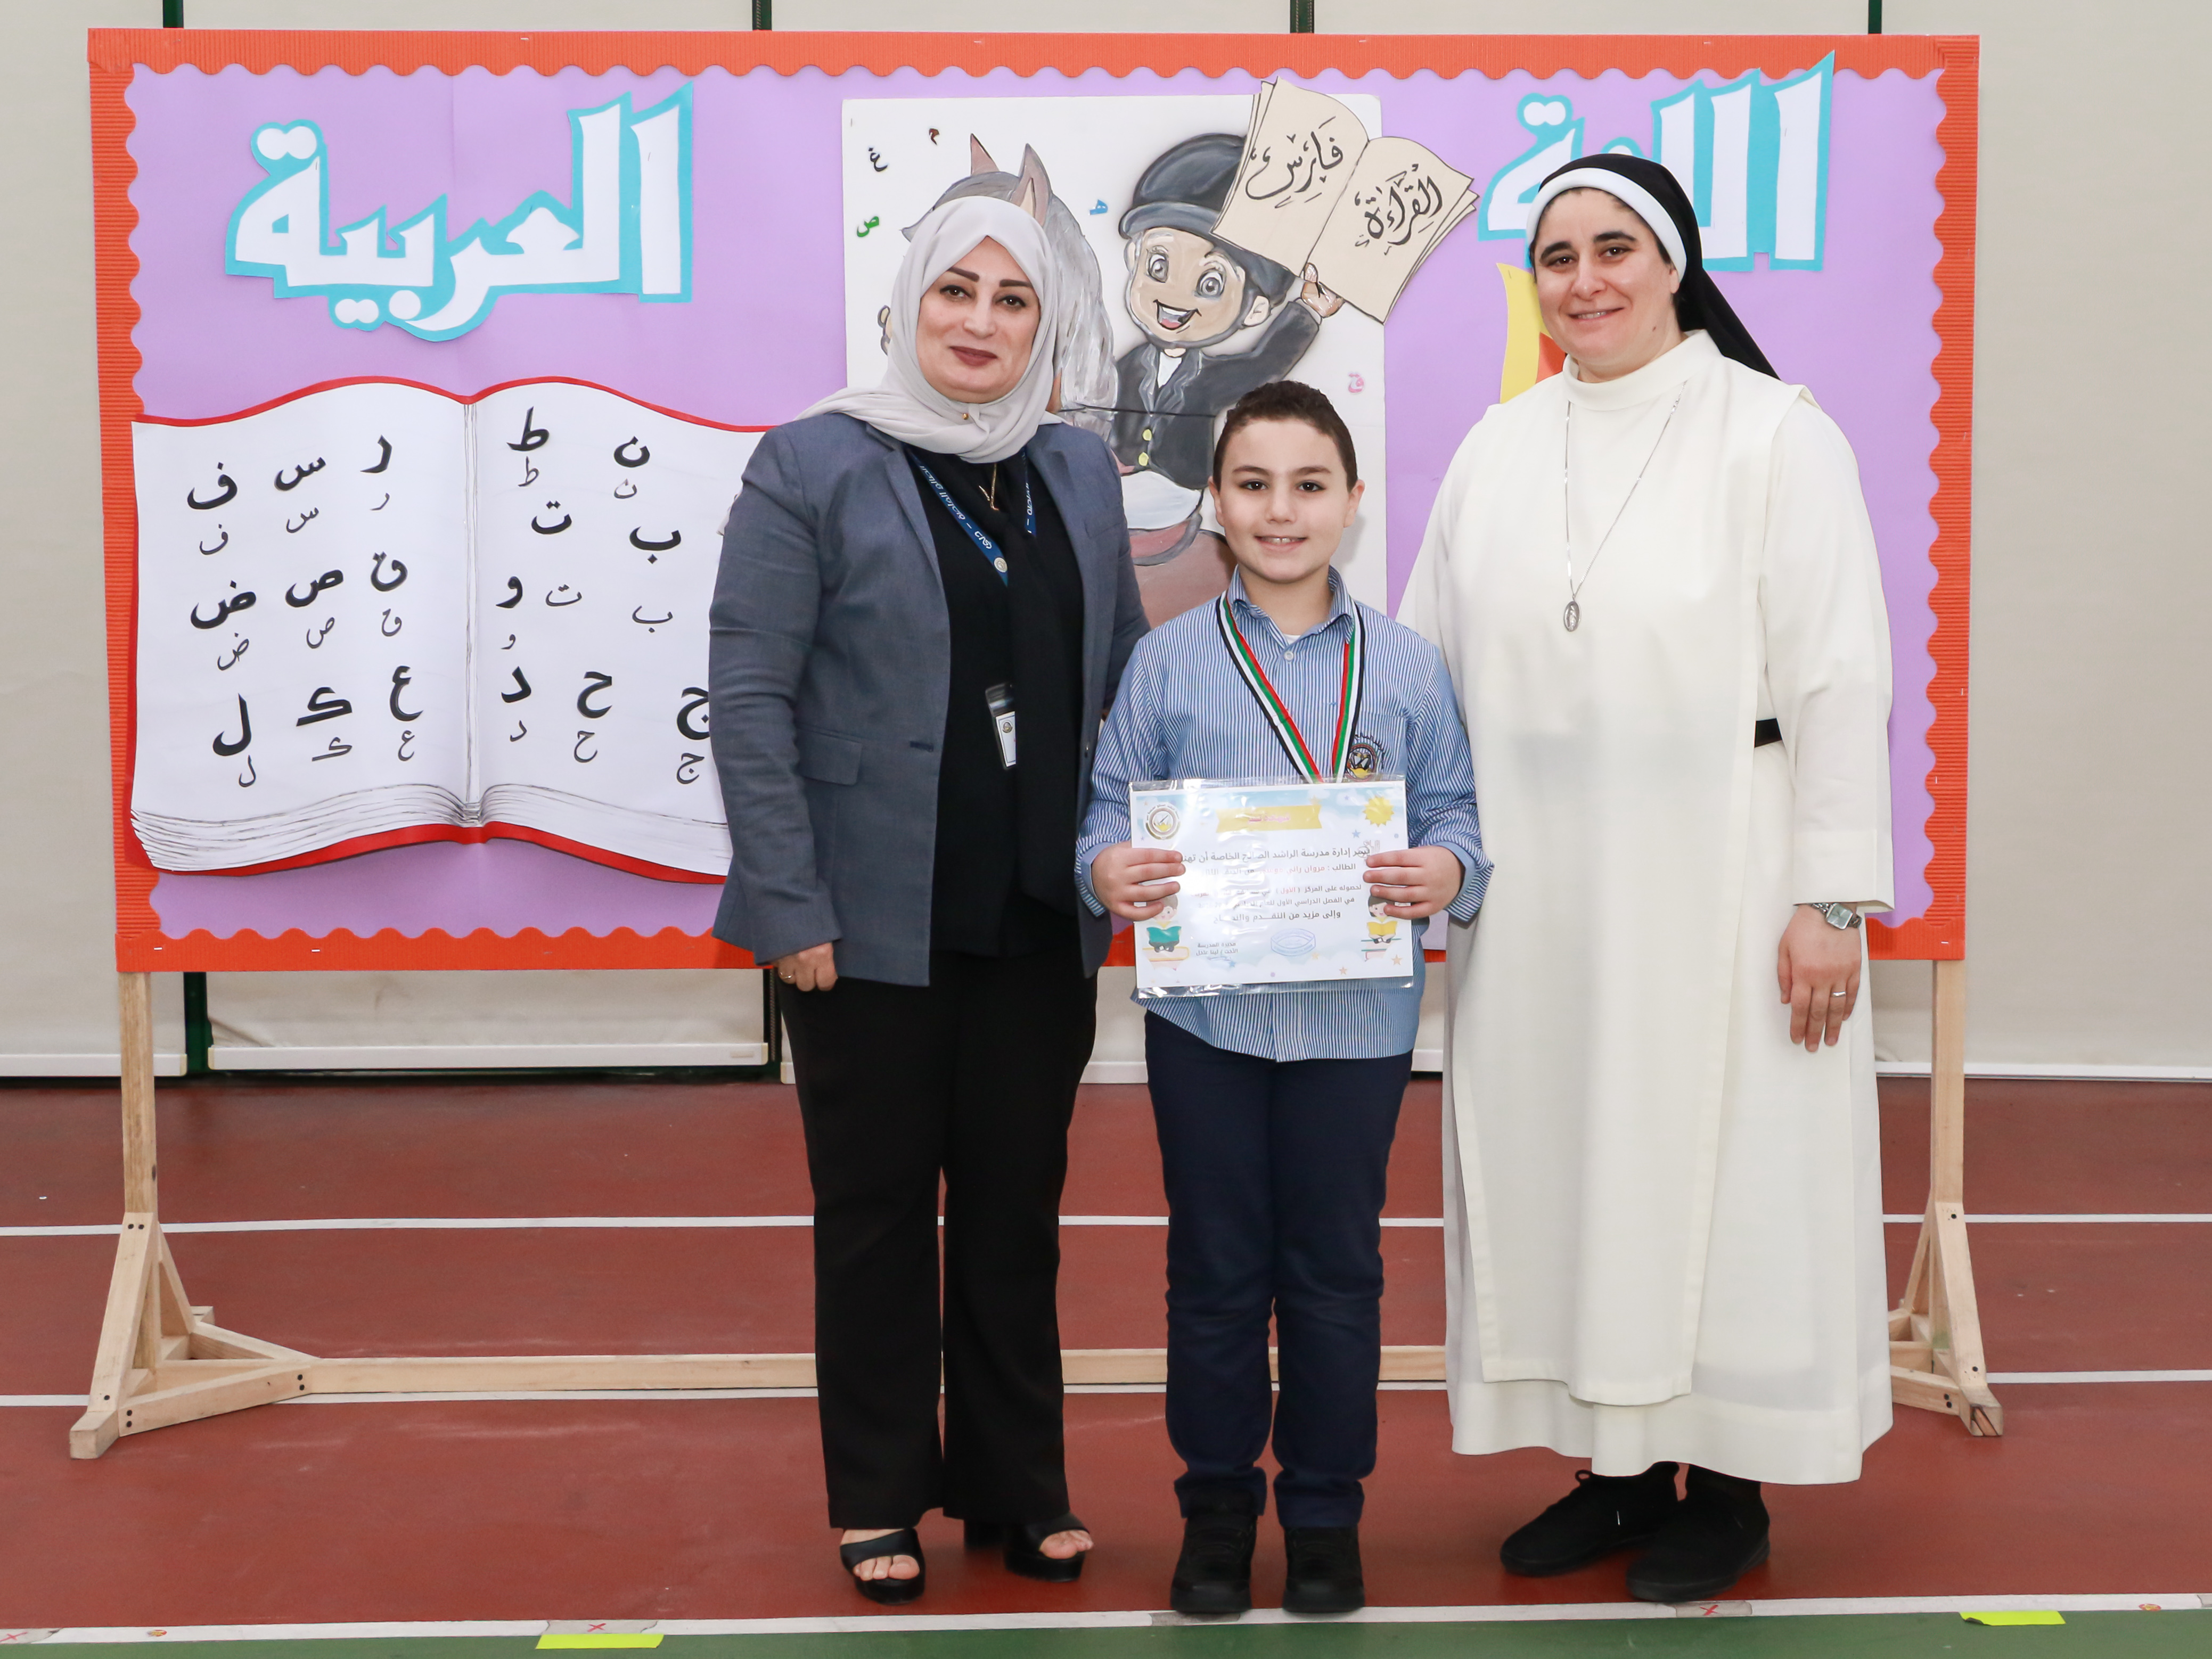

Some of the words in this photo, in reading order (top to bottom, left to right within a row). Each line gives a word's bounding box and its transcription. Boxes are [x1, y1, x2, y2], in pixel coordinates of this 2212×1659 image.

[1483, 63, 1828, 266] اللة
[231, 94, 686, 335] العربية
[857, 216, 879, 237] ص
[507, 407, 550, 451] ط
[361, 436, 392, 473] ر
[614, 436, 650, 467] ن
[187, 462, 237, 510] ف
[274, 457, 326, 491] س
[518, 456, 539, 487] ط
[371, 493, 389, 511] ر
[614, 479, 637, 499] ن
[286, 507, 319, 533] س
[531, 501, 572, 535] ت
[199, 524, 228, 555] ف
[629, 527, 681, 564] ب
[974, 531, 992, 549] دبي
[371, 552, 407, 592] ق
[285, 570, 343, 607] ص
[496, 576, 523, 609] و
[545, 584, 582, 606] ت
[191, 580, 256, 629] ض
[632, 606, 673, 633] ب
[306, 617, 334, 649] ص
[381, 609, 402, 637] ق
[217, 633, 249, 671] ض
[501, 634, 516, 650] و
[390, 666, 423, 721] ع
[501, 666, 531, 703] د
[577, 671, 612, 719] ح
[296, 687, 352, 727] ك
[677, 687, 710, 740] ج
[212, 693, 251, 757] ل
[510, 720, 527, 742] د
[312, 737, 352, 761] ك
[398, 730, 415, 761] ع
[574, 730, 597, 763] ح
[239, 754, 256, 787] ل
[676, 753, 704, 784] ج
[1182, 854, 1197, 864] تهن
[1199, 851, 1208, 863] أن
[1210, 852, 1240, 860] الخاصة
[1273, 849, 1298, 859] الراشد
[1300, 848, 1330, 859] مدرسة
[1332, 847, 1351, 858] إدارة
[1332, 863, 1356, 872] الطالب
[1304, 865, 1325, 874] مروان
[1288, 912, 1300, 921] من
[1295, 898, 1321, 907] الدراسي
[1302, 911, 1320, 920] مزيد
[1322, 910, 1341, 919] وإلى
[1323, 897, 1342, 905] الفصل
[1344, 897, 1355, 905] في
